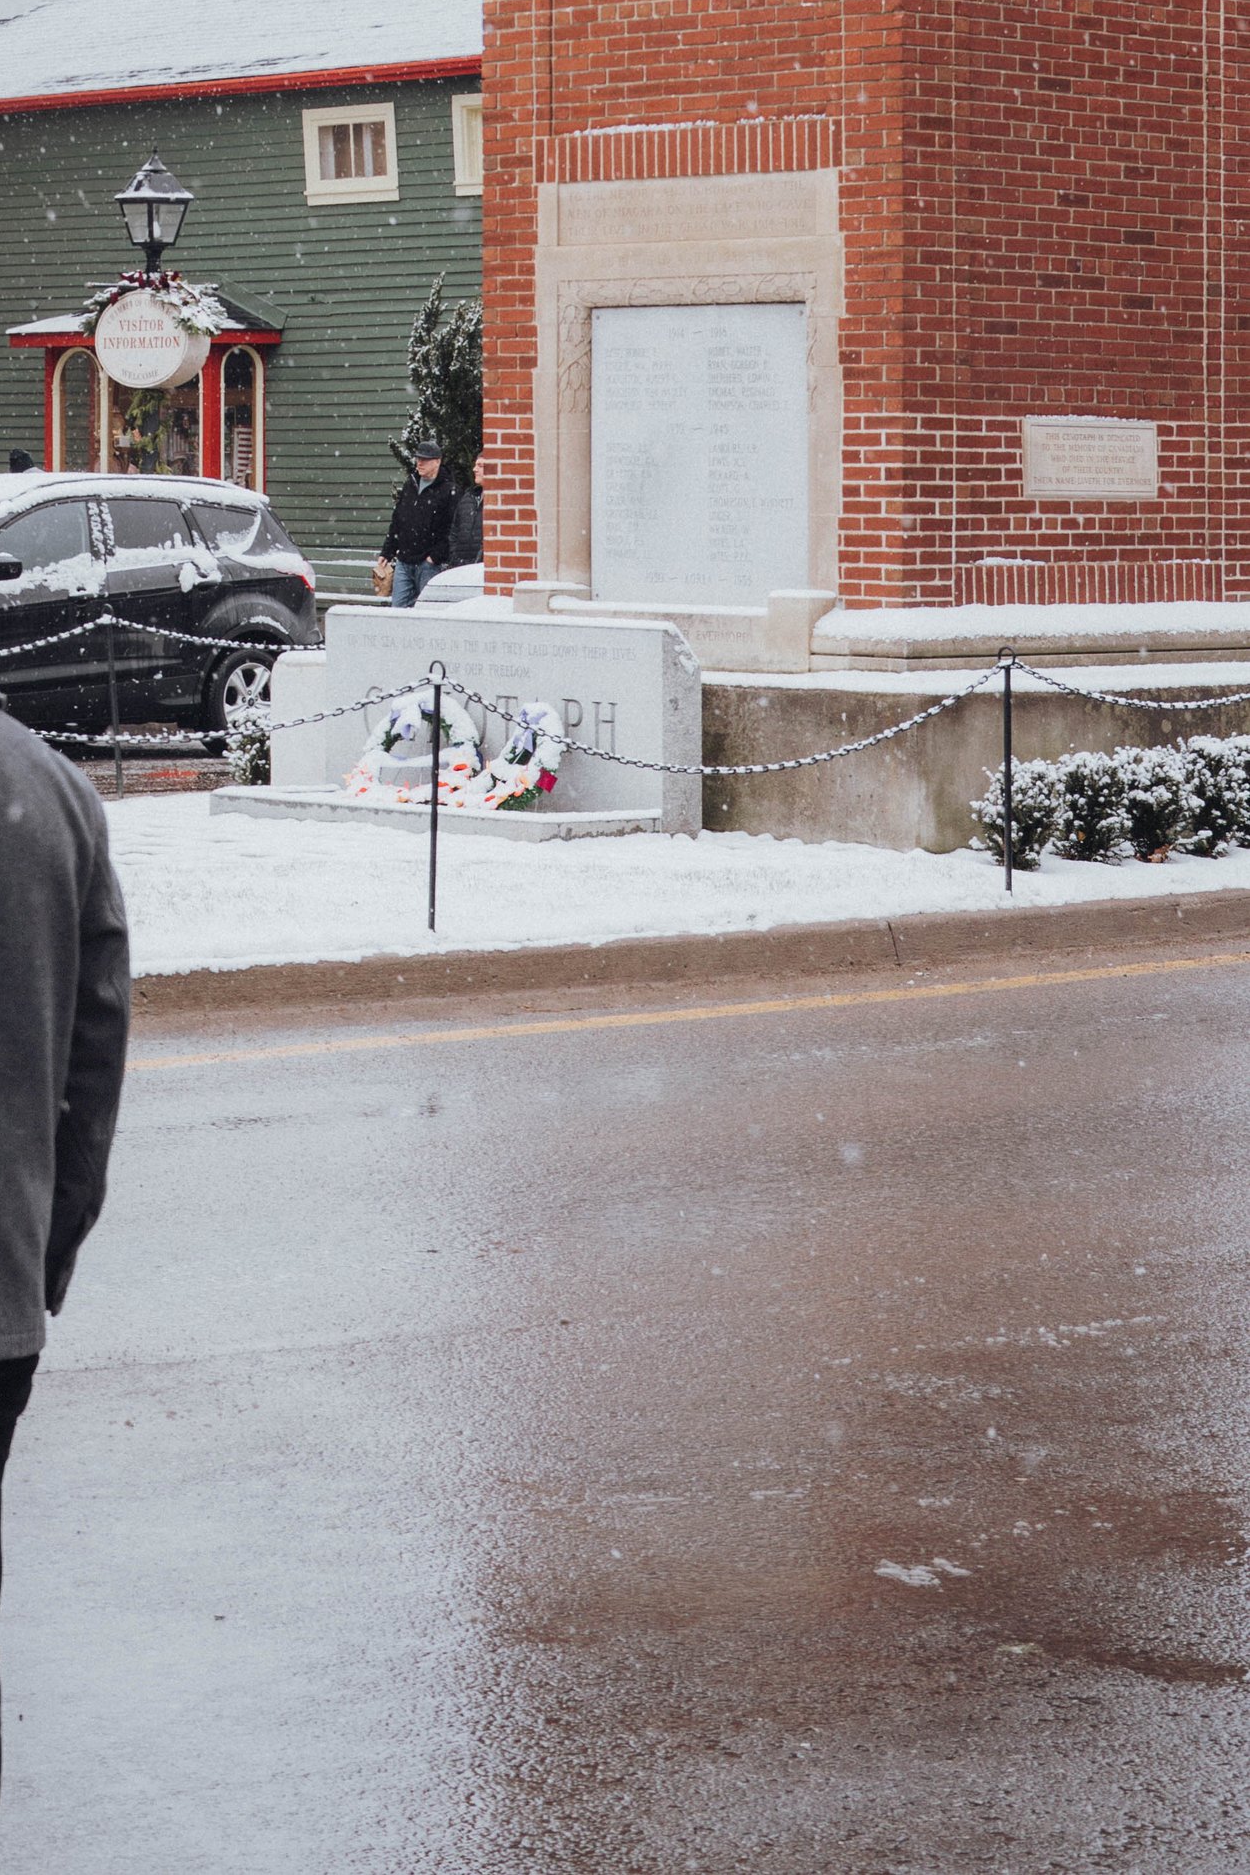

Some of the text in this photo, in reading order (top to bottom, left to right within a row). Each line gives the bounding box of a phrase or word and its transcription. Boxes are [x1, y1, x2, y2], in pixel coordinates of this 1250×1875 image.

[119, 319, 164, 331] VISITOR
[103, 336, 181, 349] INFORMATION
[121, 368, 159, 381] WELCOME
[1045, 432, 1060, 441] THIS
[1062, 432, 1096, 442] CENOTAPH
[1098, 433, 1104, 442] IS
[1053, 443, 1066, 452] THE
[1033, 476, 1053, 486] THEIR
[463, 638, 479, 653] THE
[502, 641, 523, 655] THEY
[527, 643, 549, 657] LAID
[552, 644, 578, 658] DOWN
[582, 645, 608, 660] THEIR
[364, 685, 619, 756] COTPH
